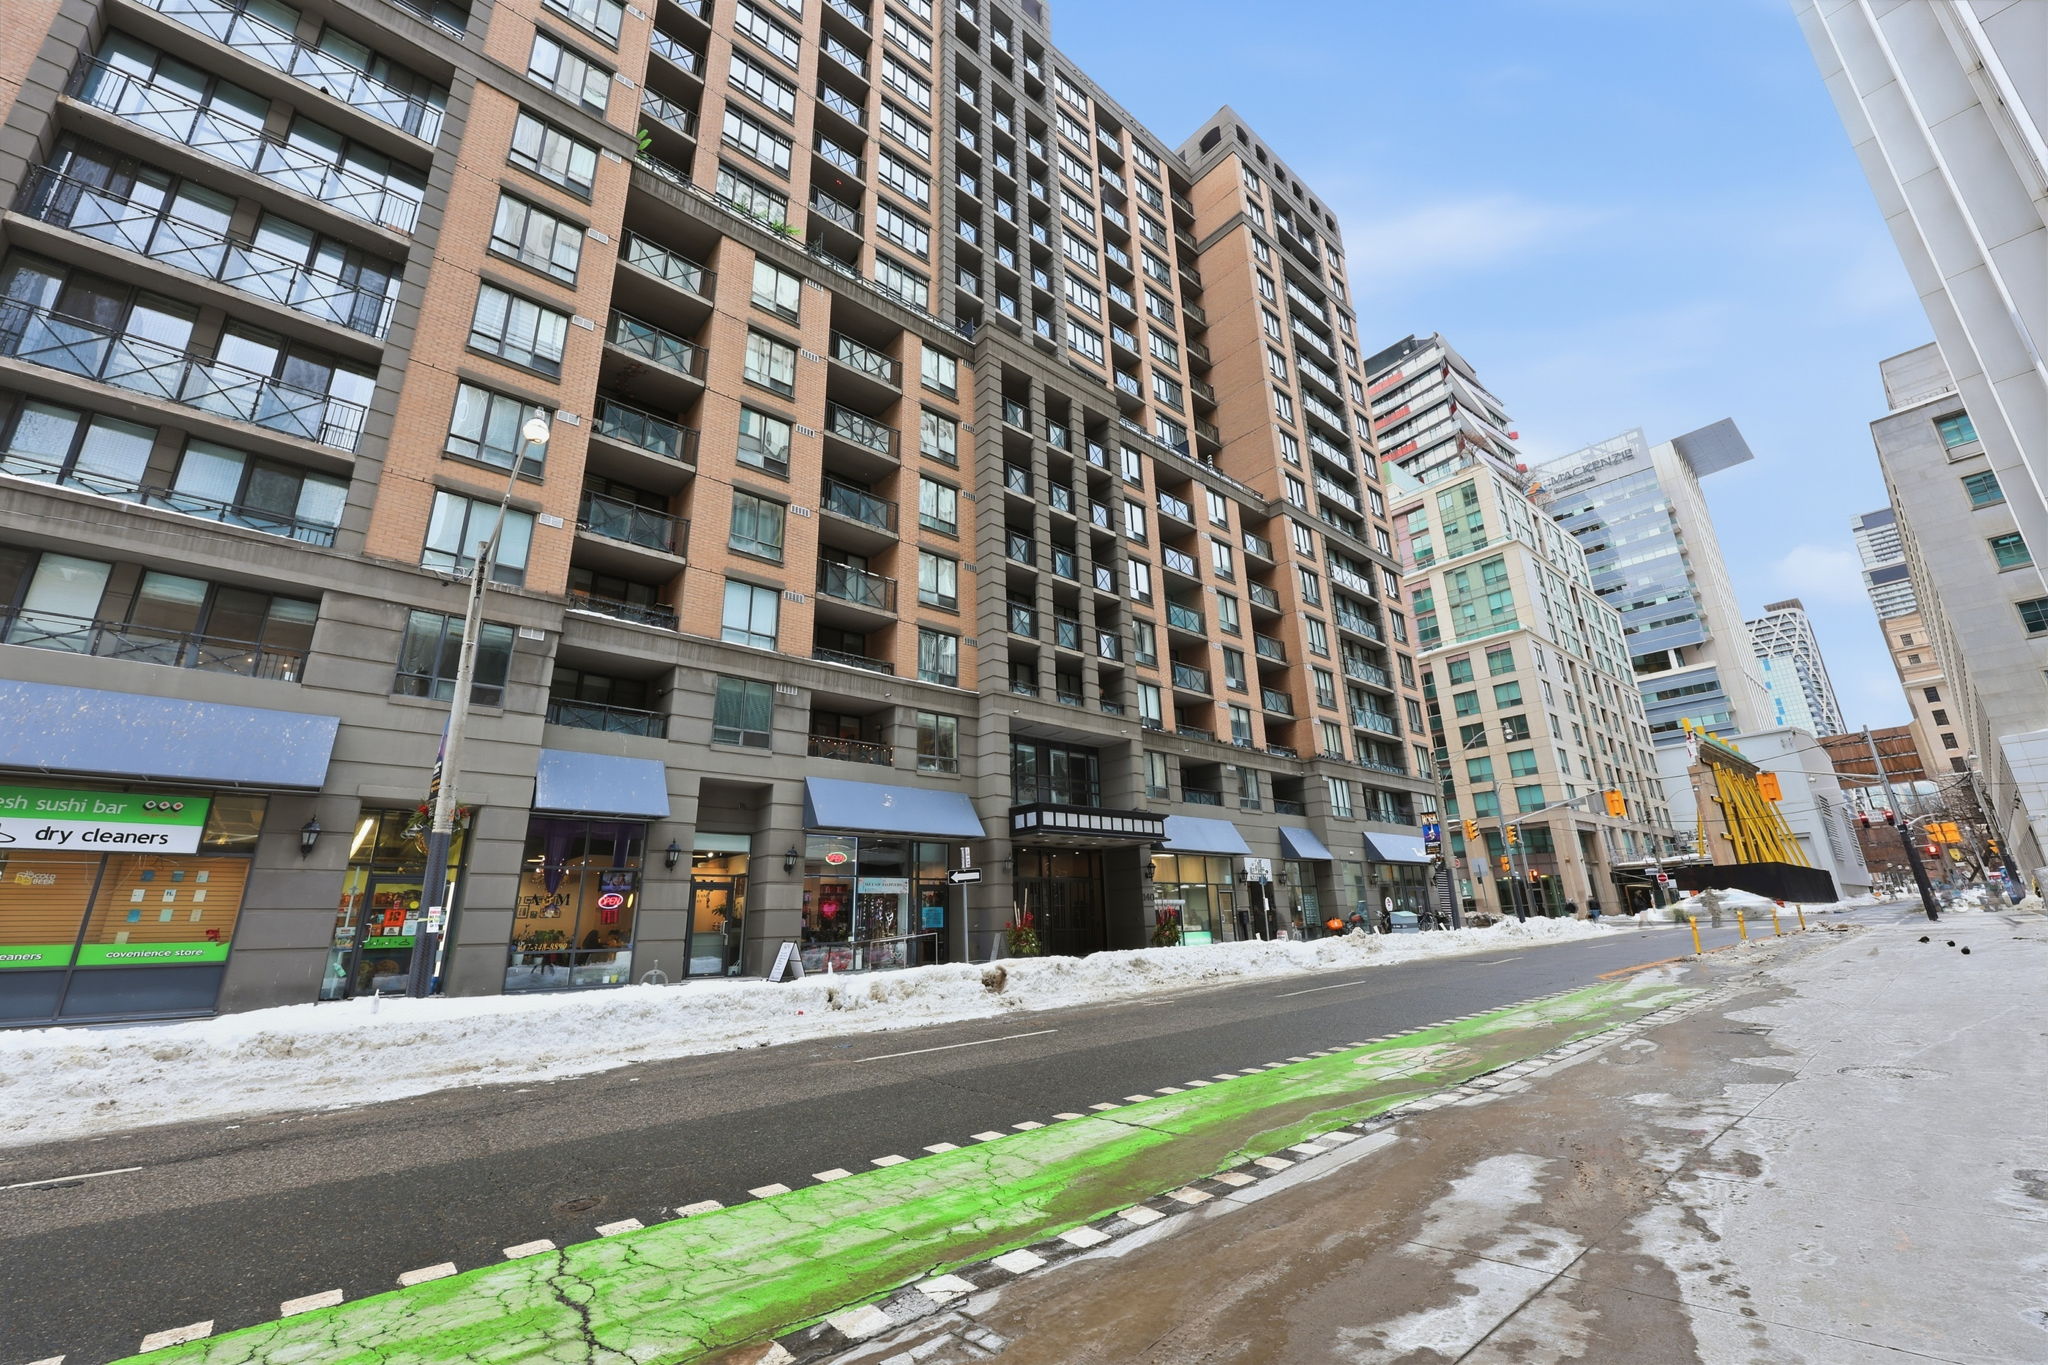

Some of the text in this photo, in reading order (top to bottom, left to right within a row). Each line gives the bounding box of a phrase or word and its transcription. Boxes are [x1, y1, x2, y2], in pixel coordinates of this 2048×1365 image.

[1550, 448, 1634, 485] MACKENZIE
[35, 798, 87, 813] sushi
[92, 799, 127, 815] bar
[35, 826, 169, 845] dry cleaners
[600, 896, 622, 906] OPEN
[106, 948, 205, 959] covenience store
